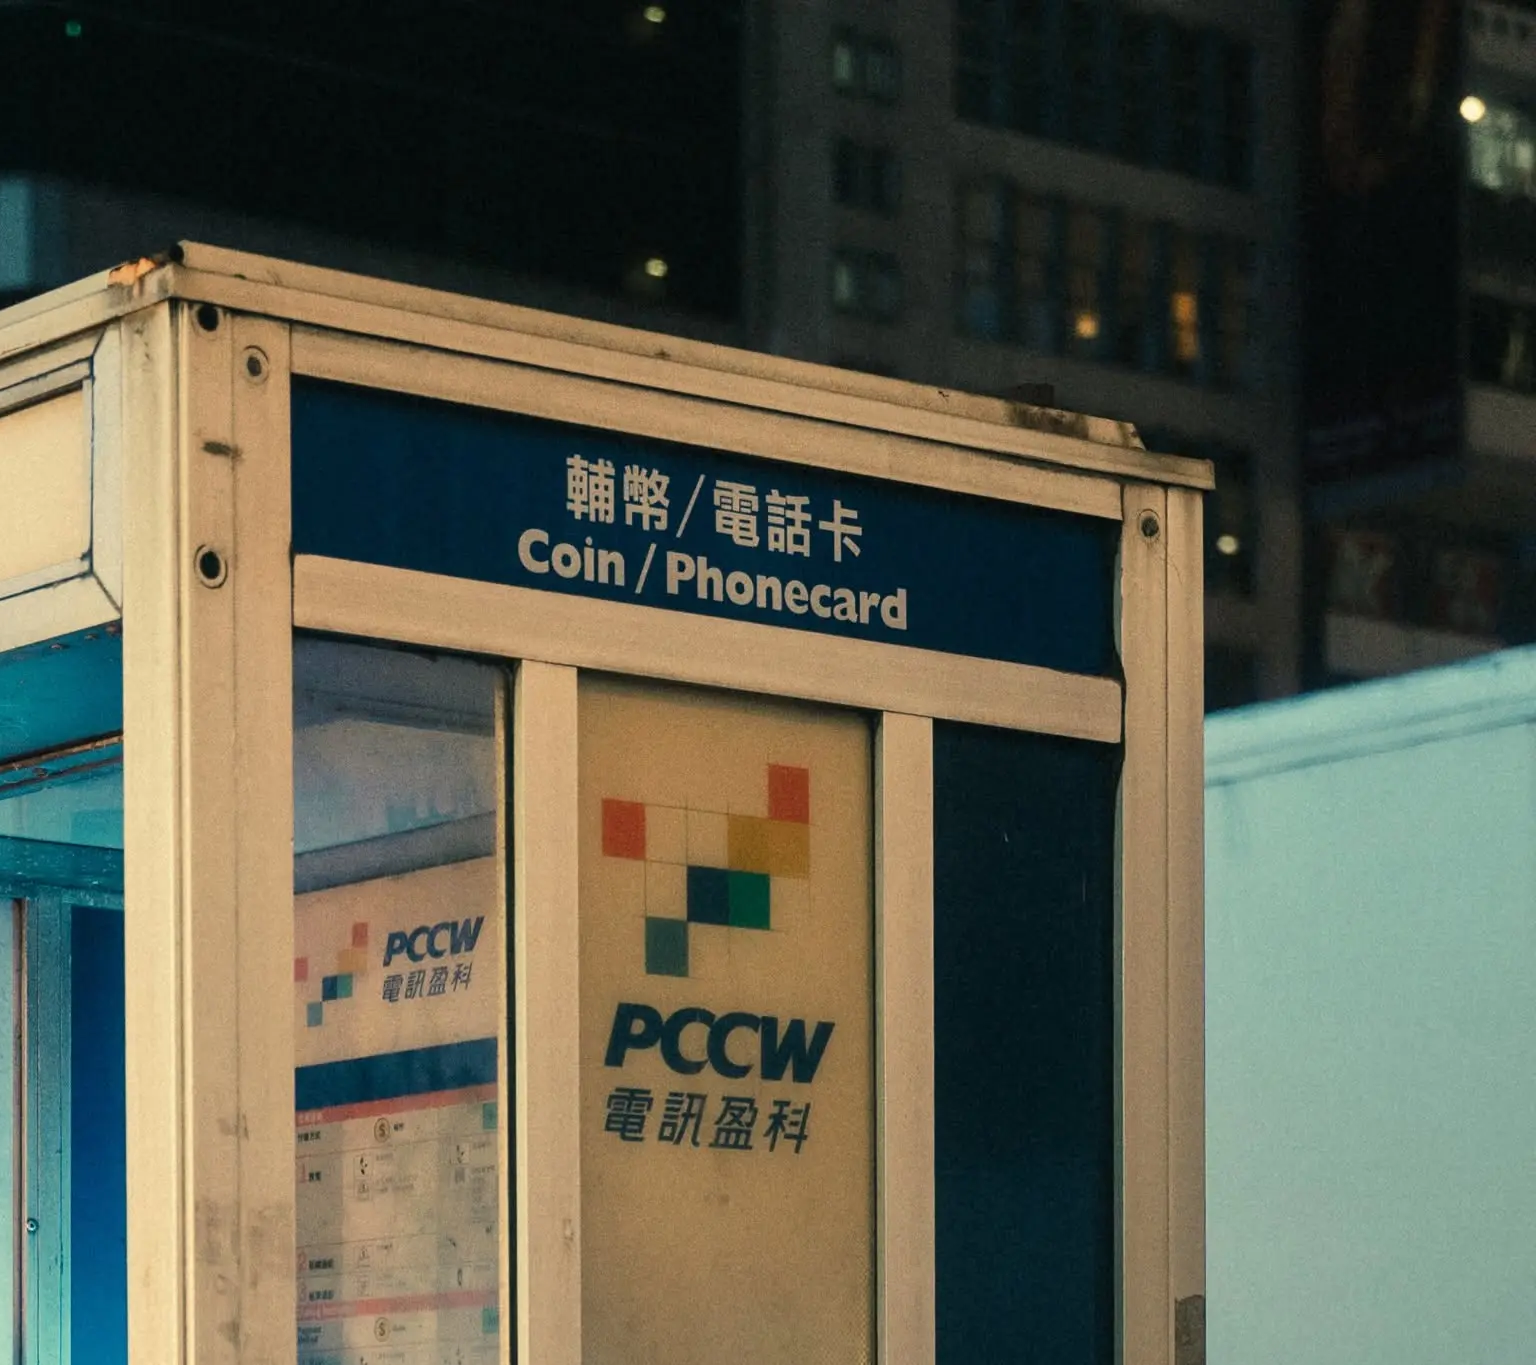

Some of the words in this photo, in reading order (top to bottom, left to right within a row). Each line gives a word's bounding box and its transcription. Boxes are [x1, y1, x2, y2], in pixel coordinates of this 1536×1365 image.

[383, 916, 485, 967] PCCW
[382, 961, 474, 1003] 電訊盈科
[604, 1003, 836, 1083] PCCW
[604, 1087, 812, 1154] 電訊盈科
